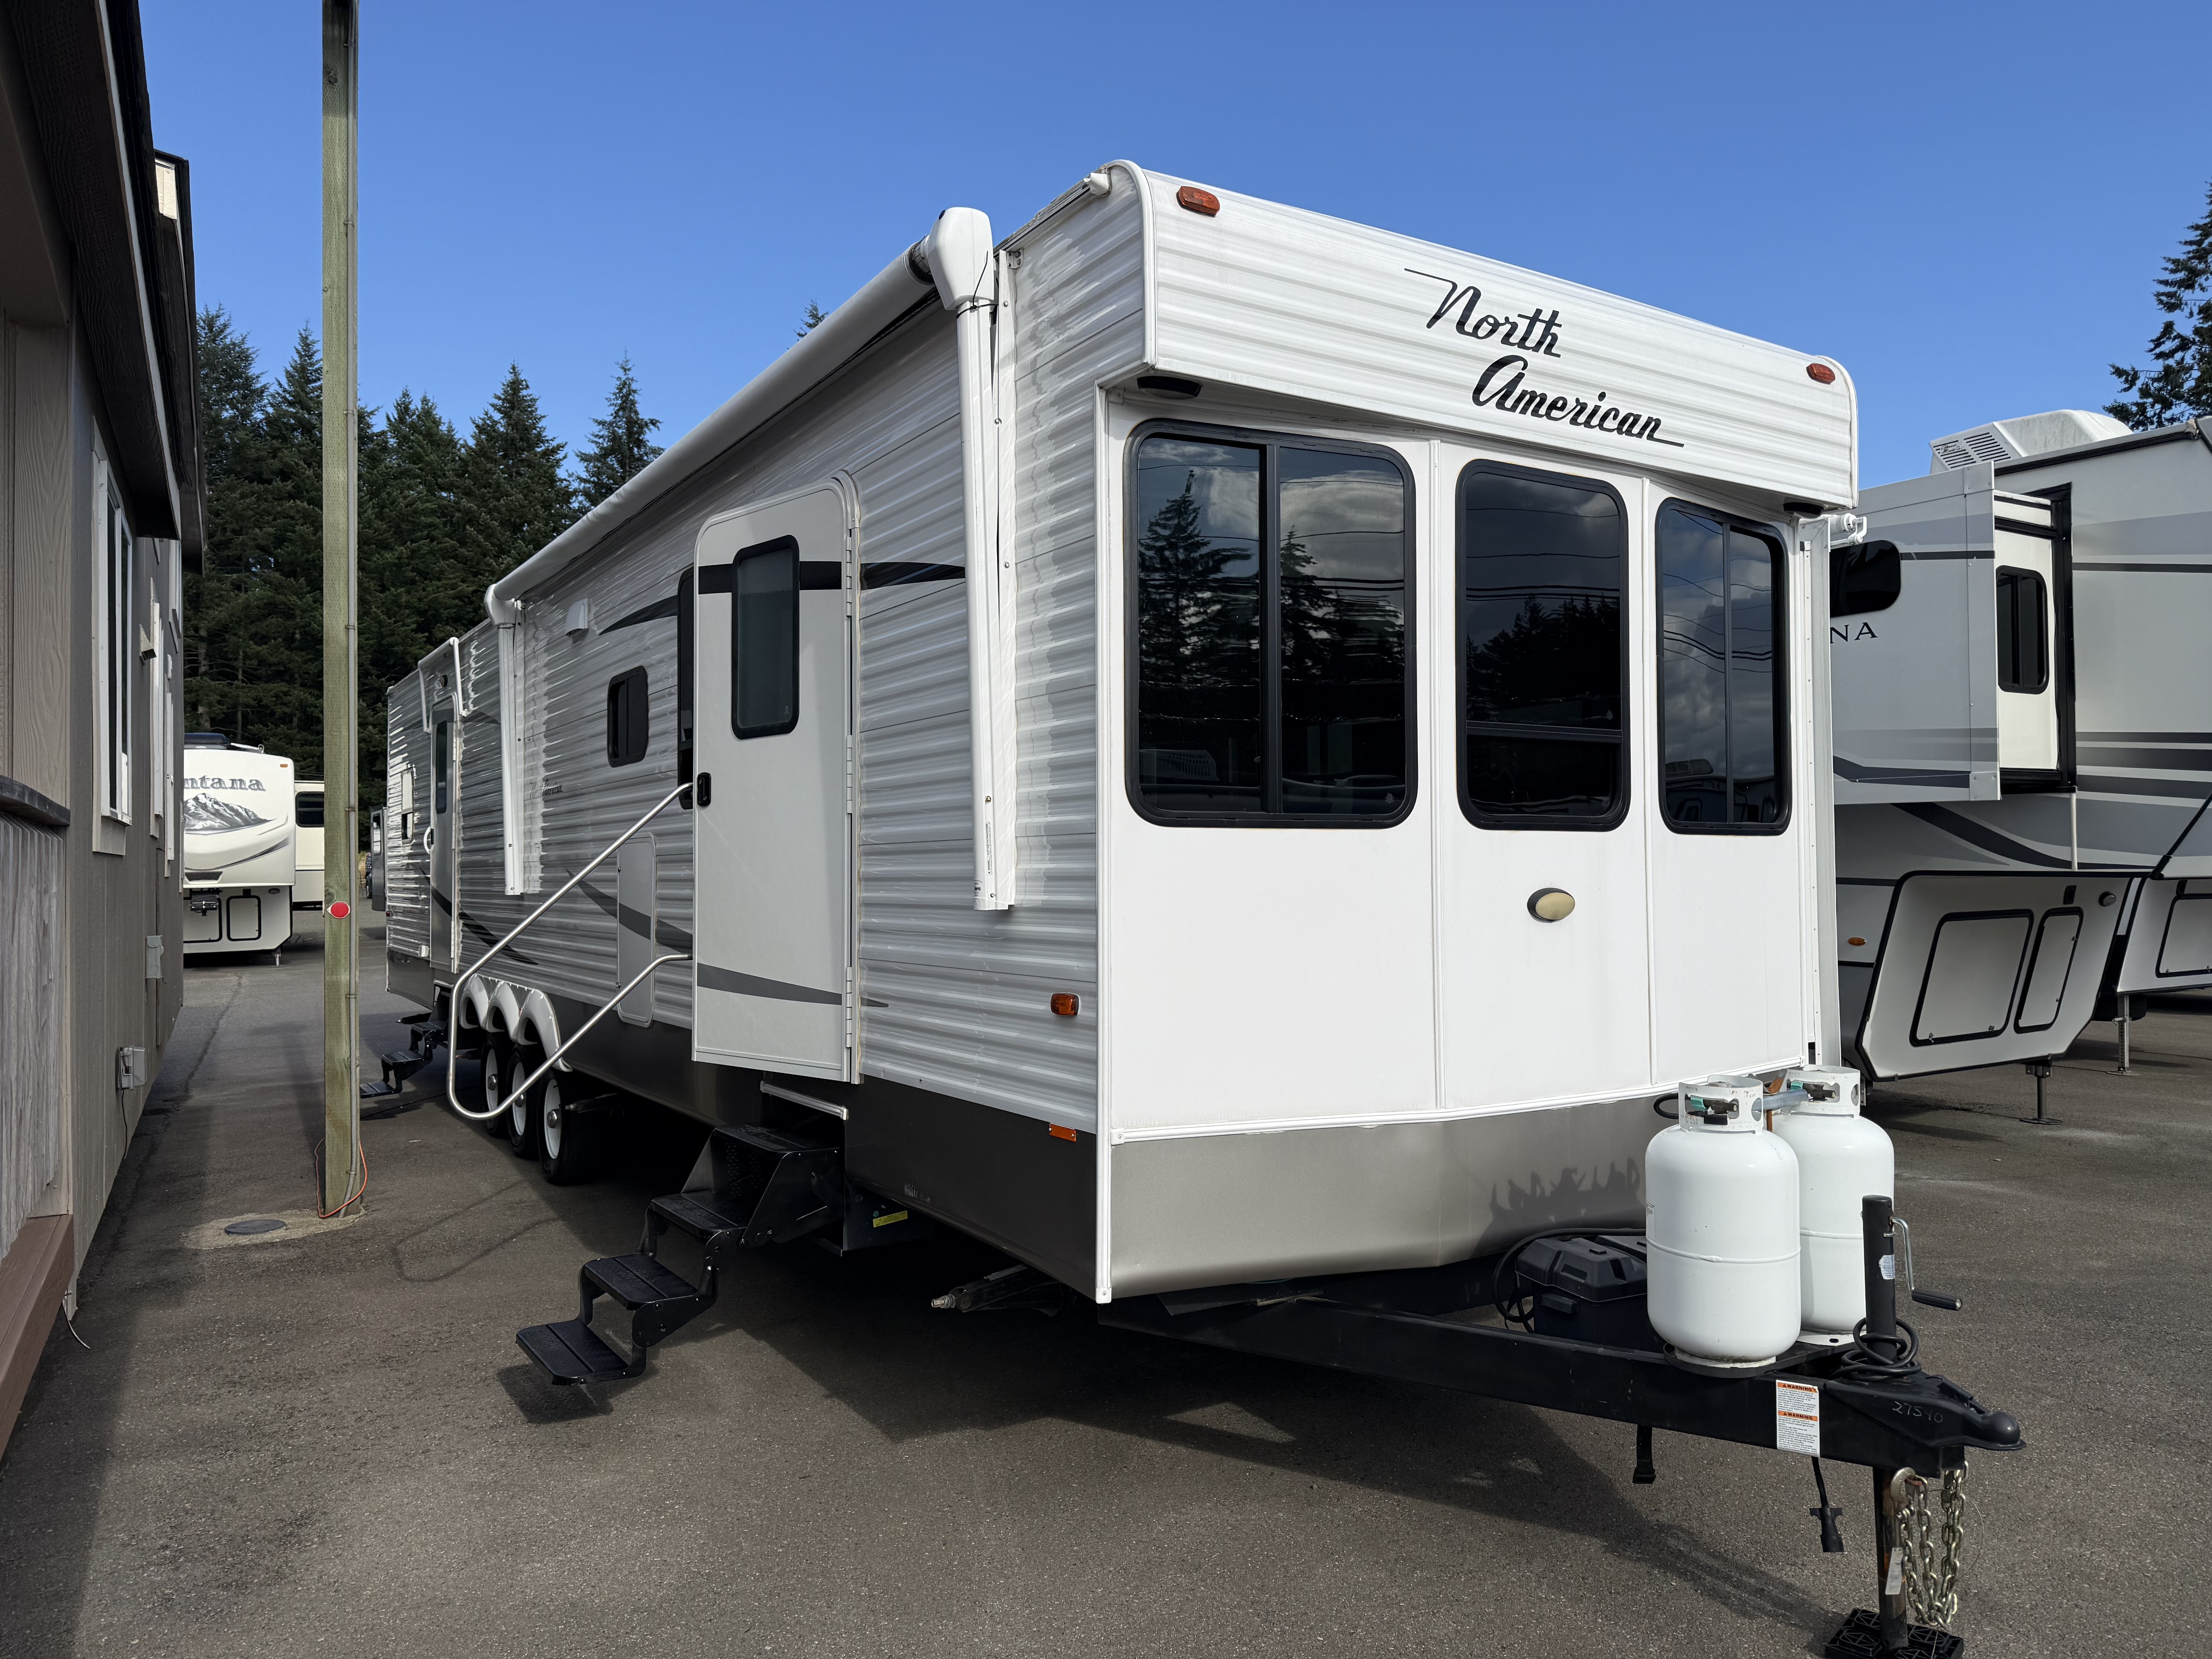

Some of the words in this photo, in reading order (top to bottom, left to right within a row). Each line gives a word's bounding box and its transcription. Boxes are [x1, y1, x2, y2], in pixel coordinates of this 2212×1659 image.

[1404, 268, 1562, 358] North
[1472, 355, 1685, 448] American
[1830, 622, 1878, 644] NA
[184, 775, 266, 792] ntana
[1892, 1401, 1943, 1422] 27540
